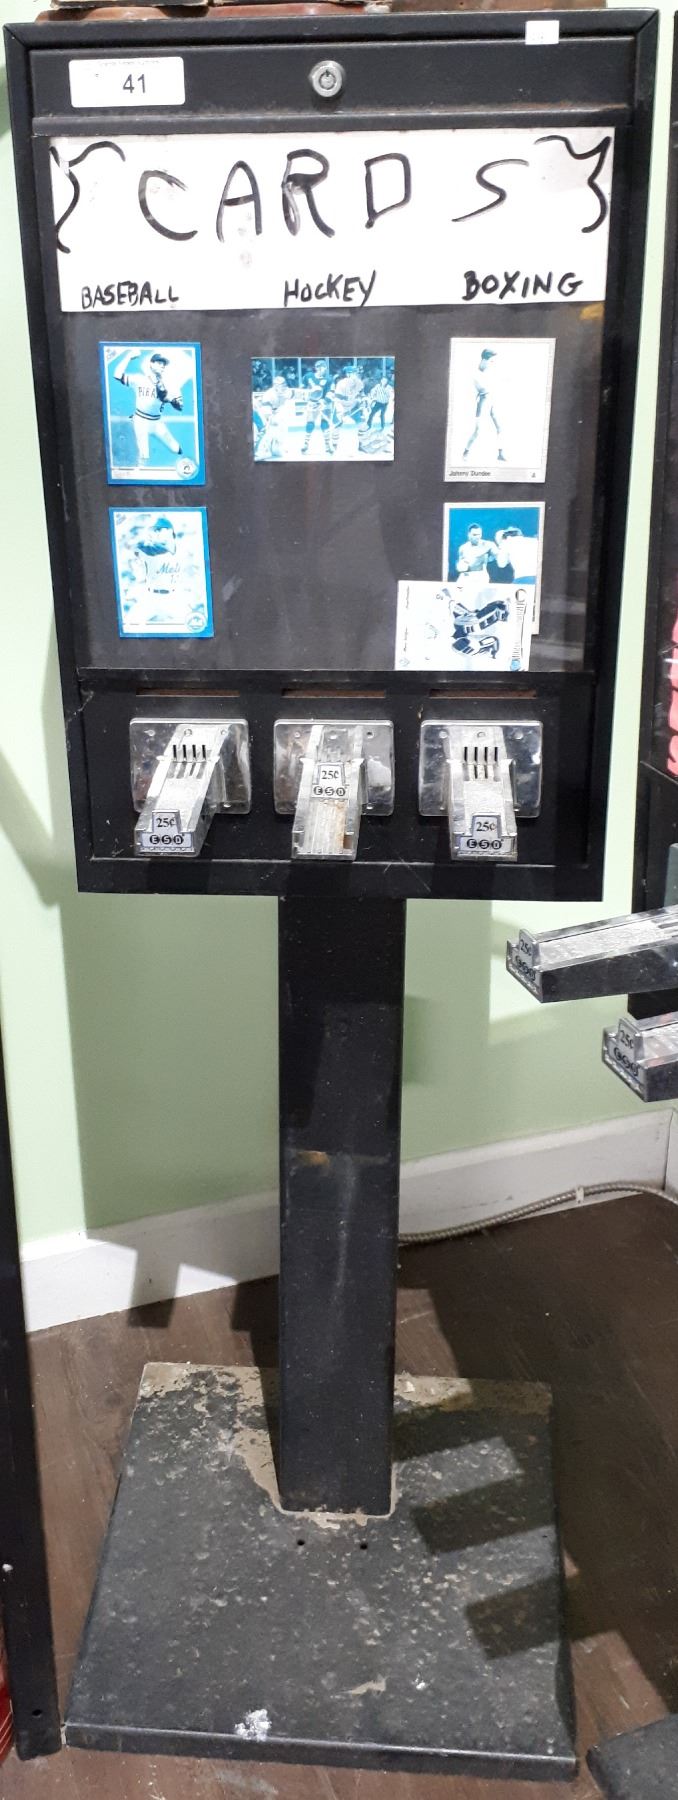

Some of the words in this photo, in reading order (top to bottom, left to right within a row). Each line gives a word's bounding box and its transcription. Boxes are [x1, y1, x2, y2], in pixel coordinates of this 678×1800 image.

[123, 74, 146, 94] 41
[138, 149, 529, 242] CARDS
[81, 281, 180, 309] BASEBALL
[283, 270, 377, 307] HOCKEY
[462, 270, 584, 301] BOXING
[321, 770, 339, 779] 25¢
[155, 817, 176, 828] 25¢
[475, 821, 496, 832] 25¢
